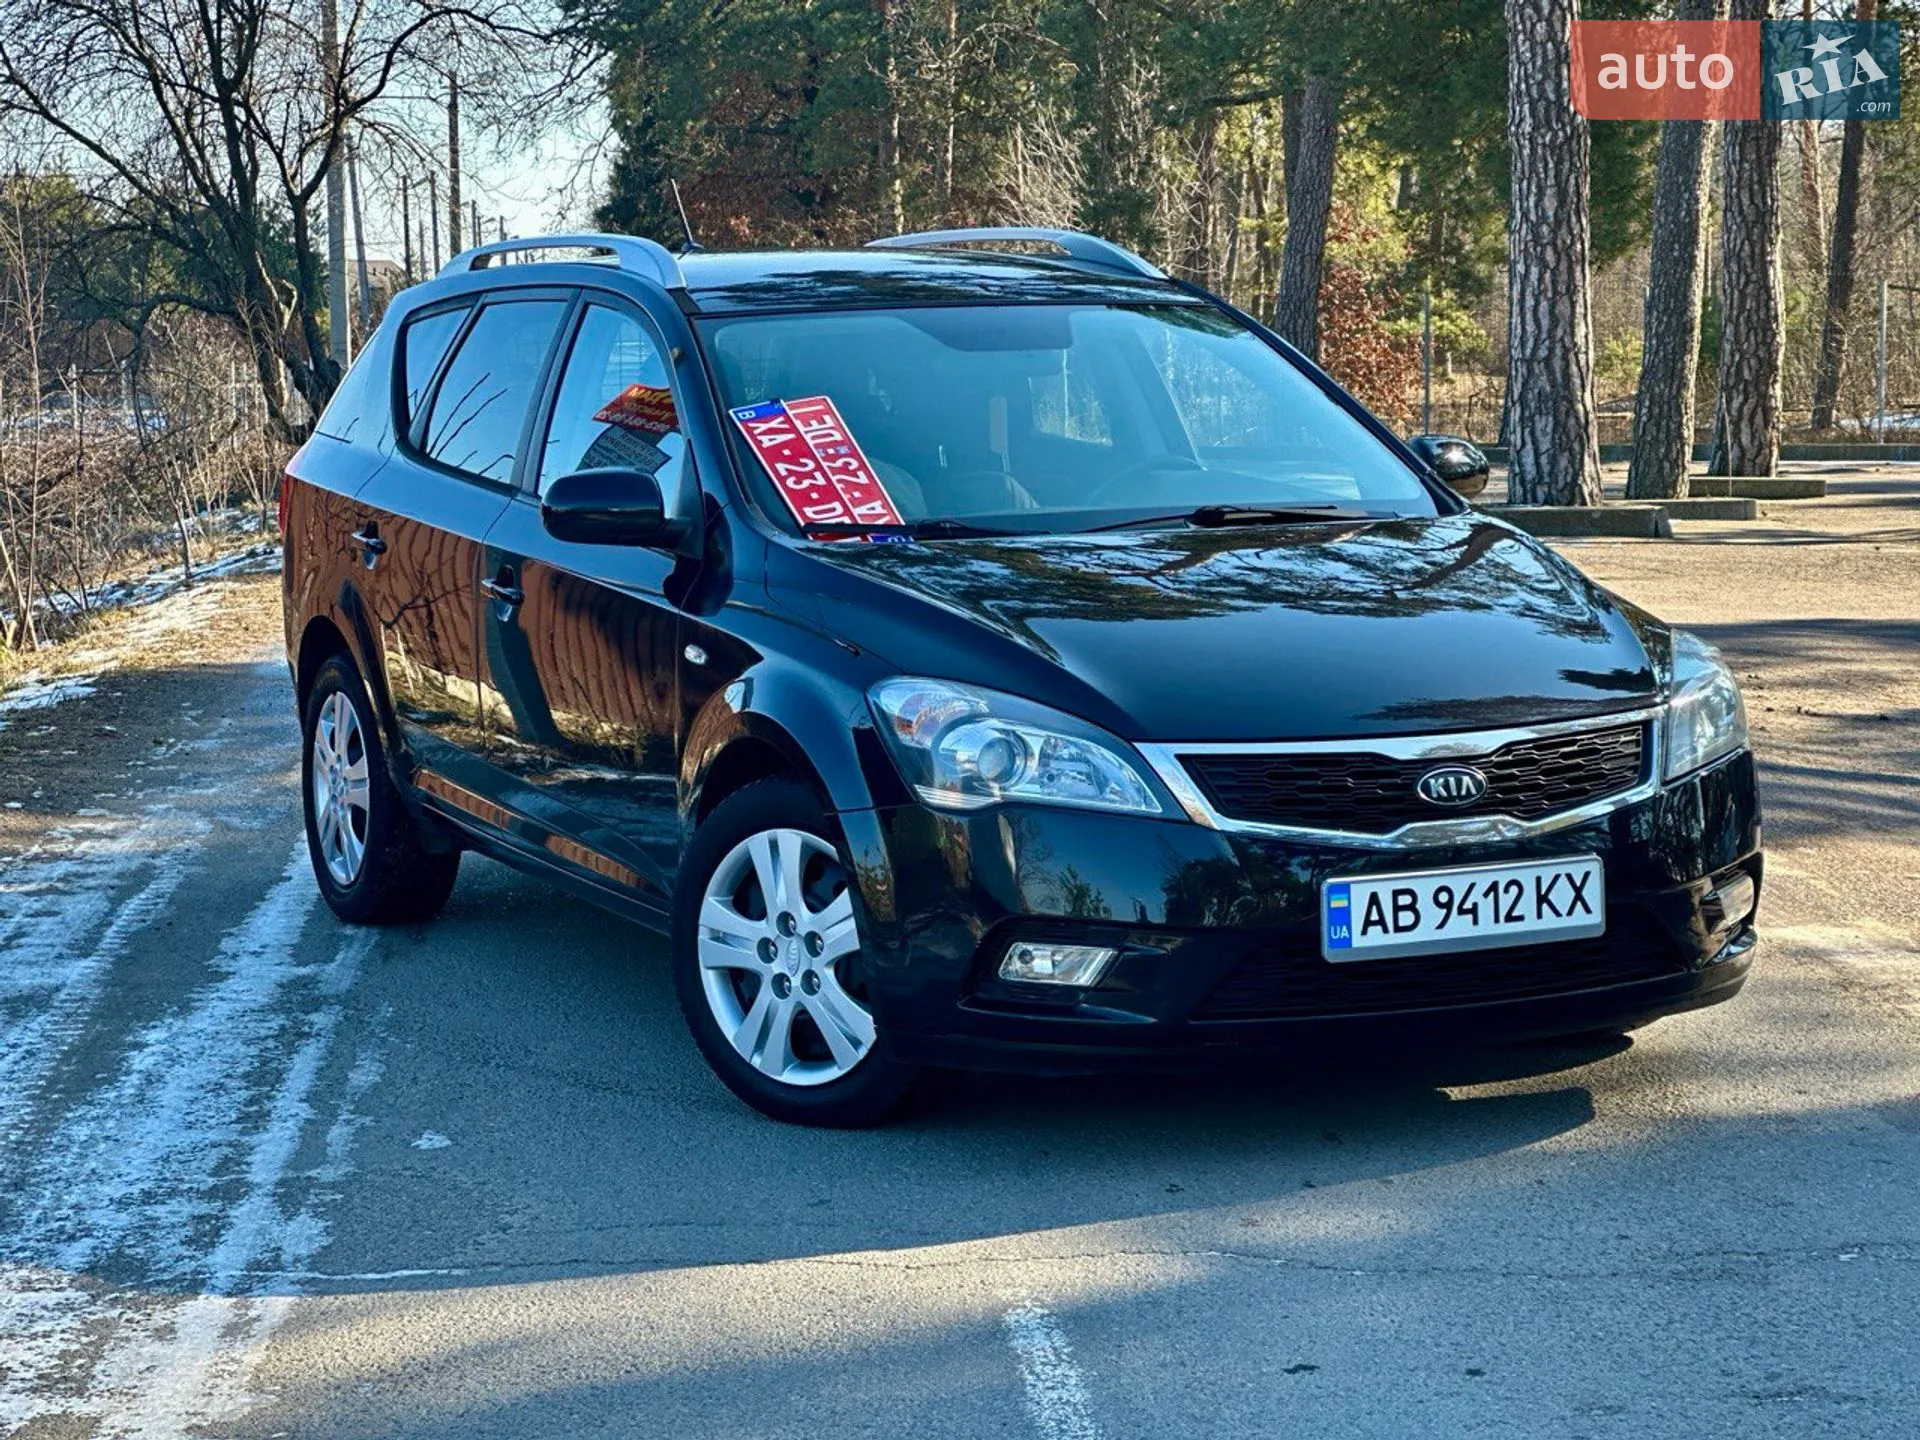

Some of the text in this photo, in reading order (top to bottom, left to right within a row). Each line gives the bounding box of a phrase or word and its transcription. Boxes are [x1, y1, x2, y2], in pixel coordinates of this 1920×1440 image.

[737, 410, 756, 420] B
[1427, 777, 1477, 798] KIA
[1360, 871, 1593, 936] AB 9412 KX
[1331, 926, 1350, 940] UA
